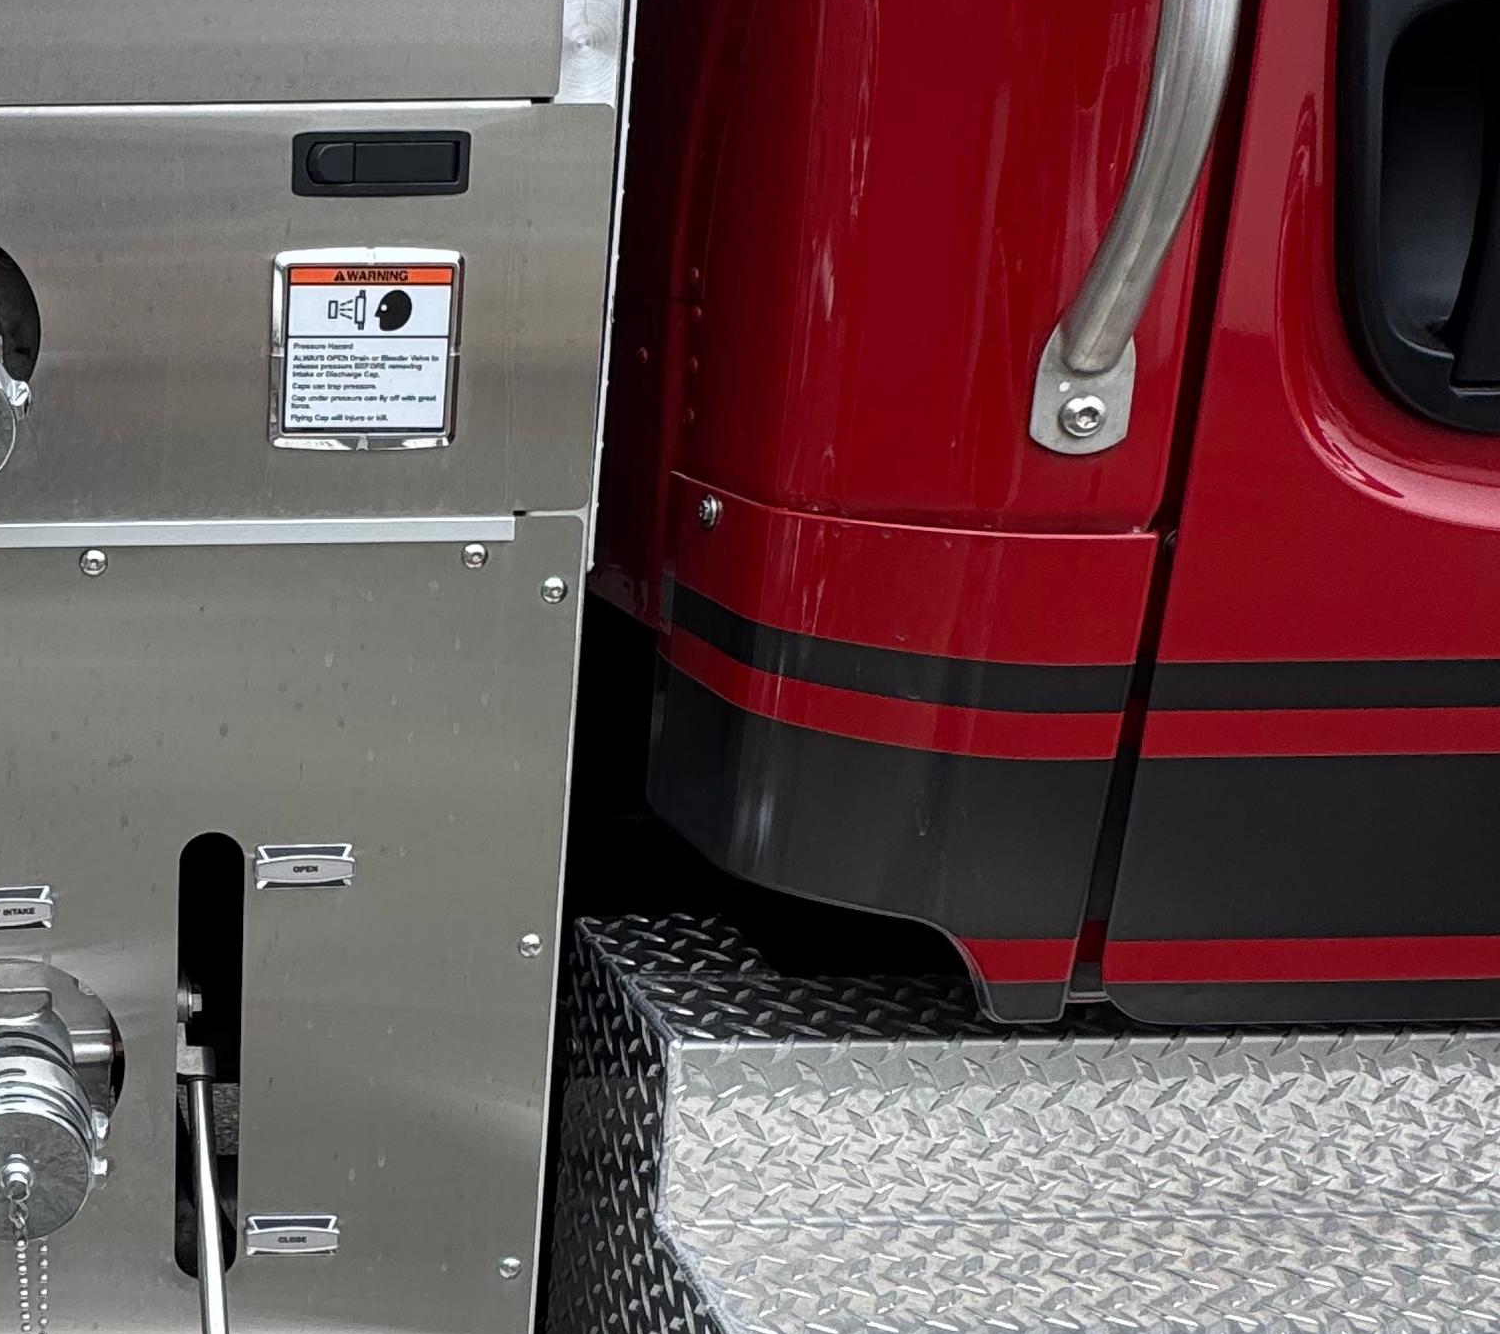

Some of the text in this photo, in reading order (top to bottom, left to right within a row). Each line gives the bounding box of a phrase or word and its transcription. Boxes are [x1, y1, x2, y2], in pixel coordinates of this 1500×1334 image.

[346, 270, 409, 282] WARNING
[292, 865, 319, 873] OPEN
[3, 907, 35, 916] INTAKE
[278, 1236, 307, 1244] CLOSE
